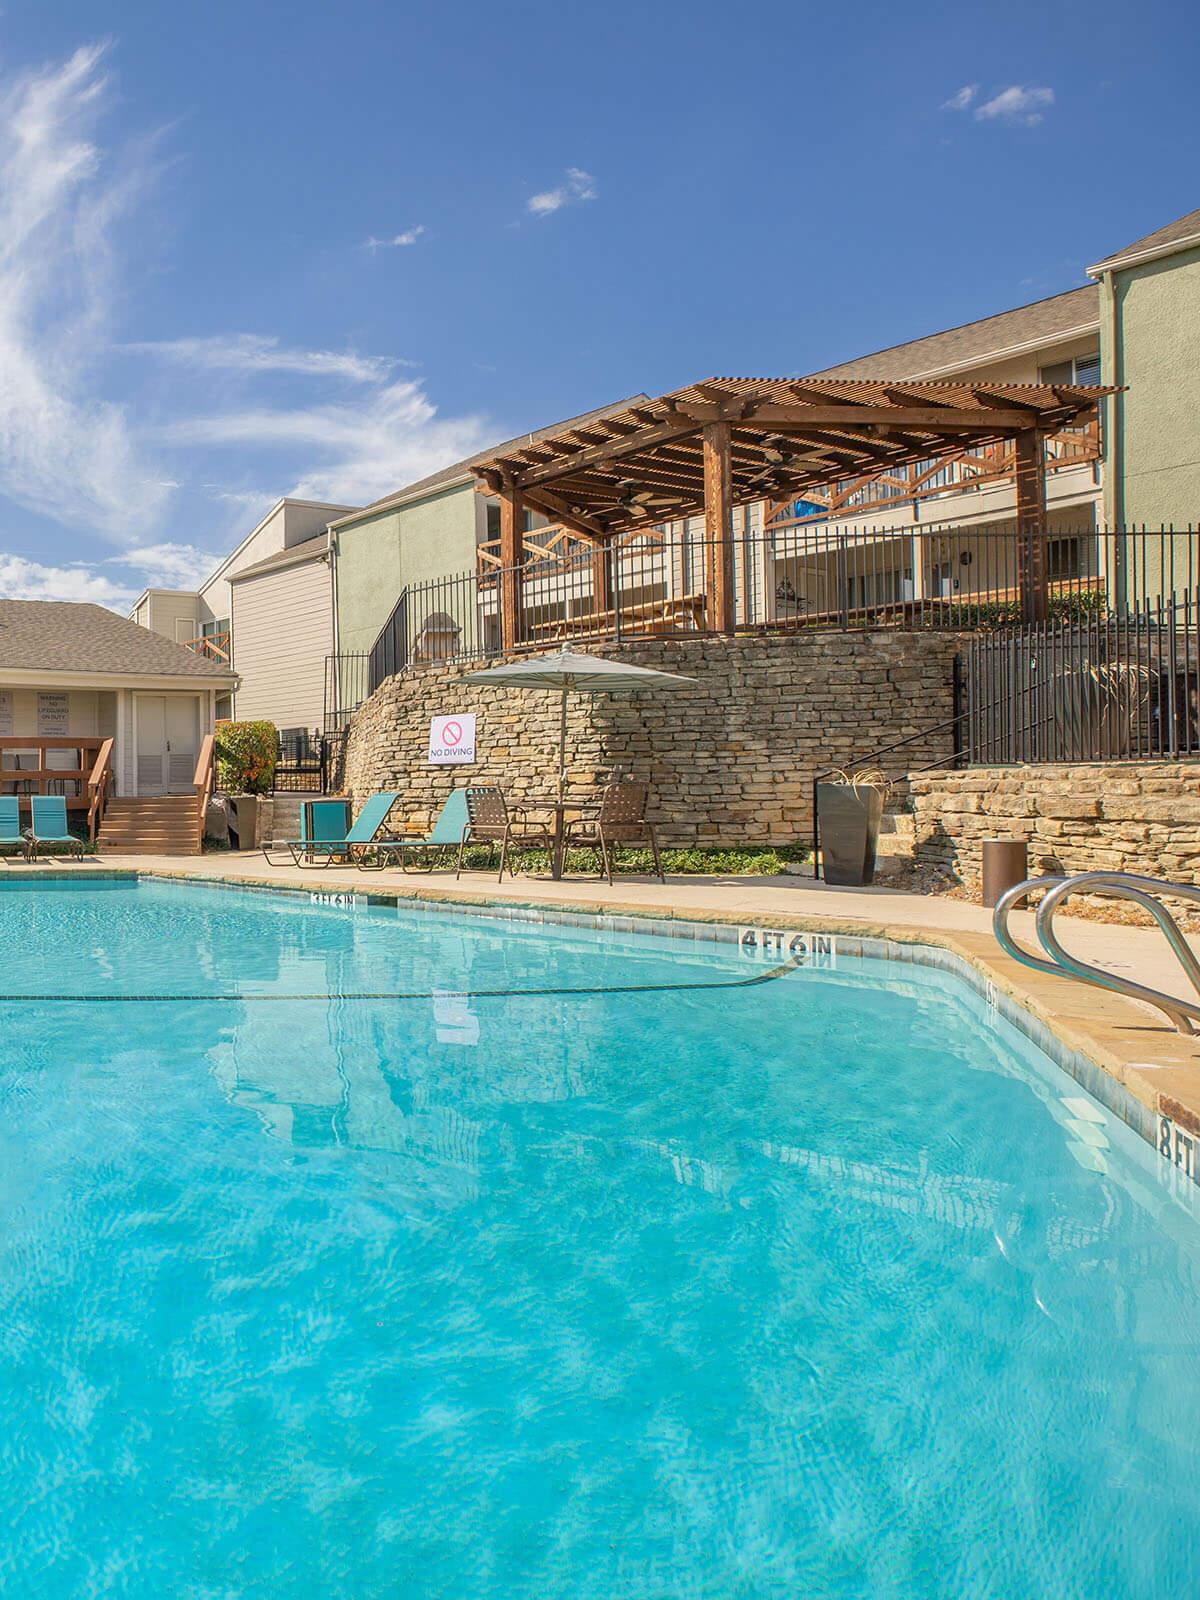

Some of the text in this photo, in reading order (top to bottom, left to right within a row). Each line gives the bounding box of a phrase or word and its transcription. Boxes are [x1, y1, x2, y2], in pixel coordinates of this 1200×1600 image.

[431, 747, 473, 757] NO DIVING
[742, 929, 832, 954] 4 FT 6 IN
[1160, 1118, 1193, 1177] 8 FT
